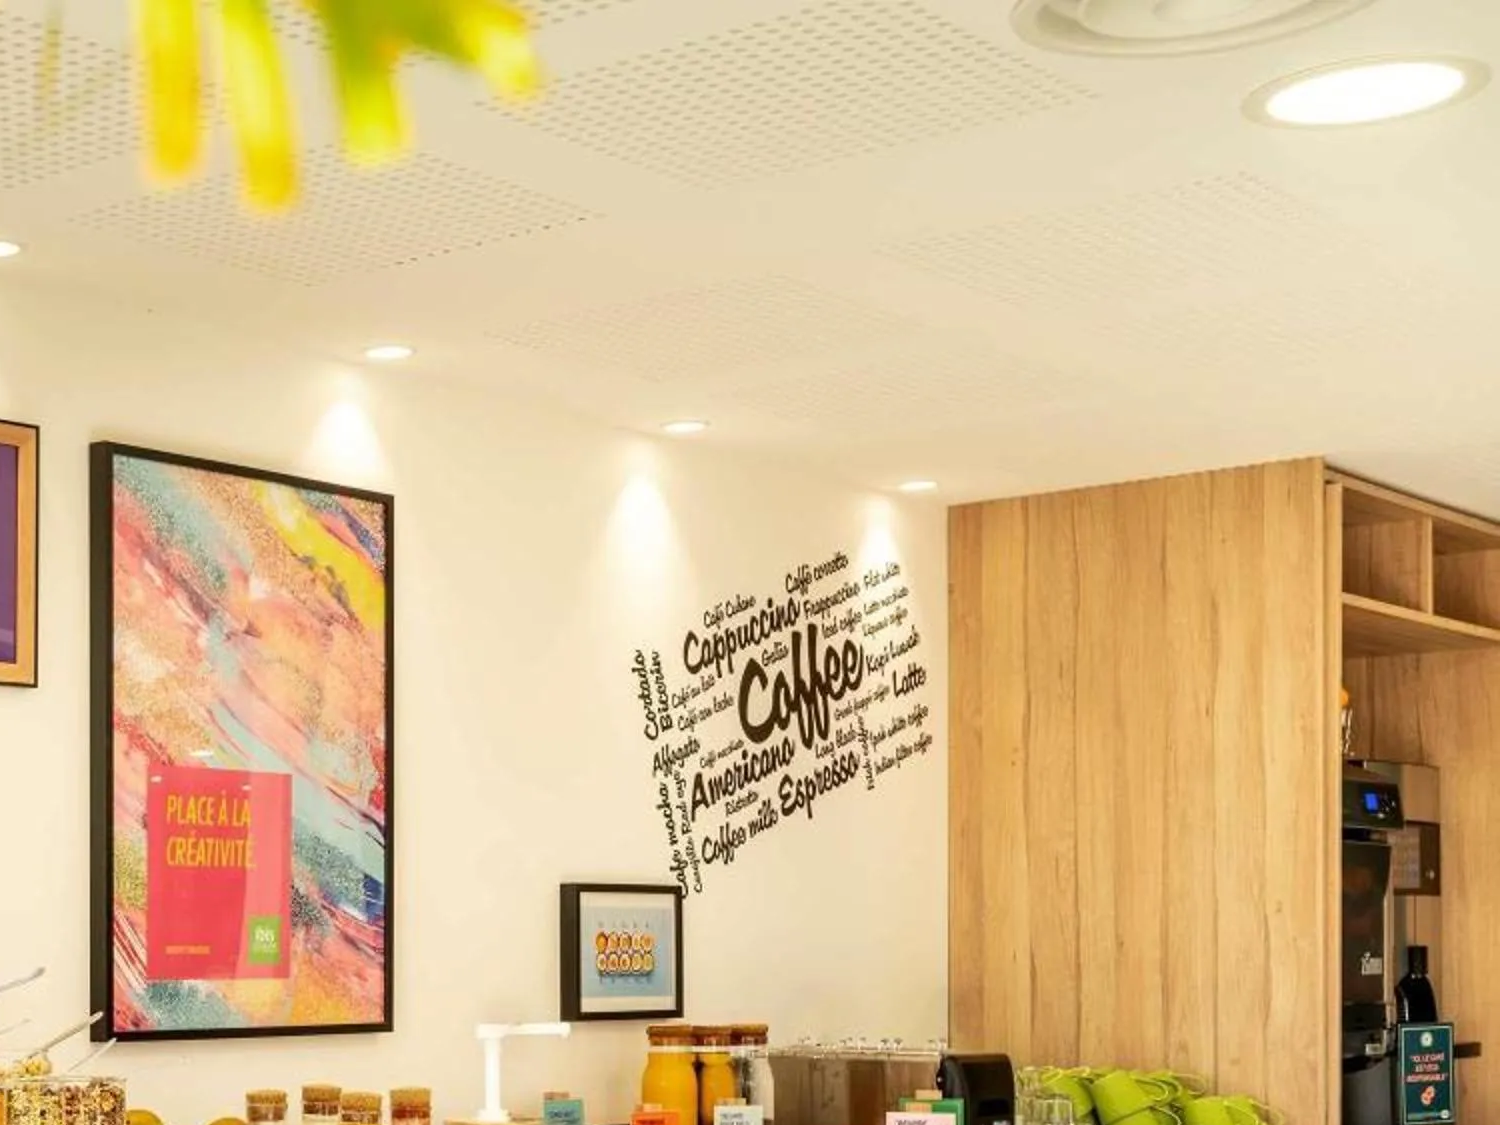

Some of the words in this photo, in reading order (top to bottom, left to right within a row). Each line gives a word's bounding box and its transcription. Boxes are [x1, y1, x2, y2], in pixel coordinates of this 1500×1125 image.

[683, 596, 801, 679] Cappuccino
[865, 645, 890, 676] Kopi
[632, 649, 659, 741] Cortado
[738, 623, 864, 749] Coffee
[892, 661, 927, 699] Latte
[652, 735, 701, 778] Affogato
[690, 736, 796, 823] Americano
[778, 750, 861, 820] Espresso
[165, 793, 215, 826] PLACE
[217, 790, 228, 826] À
[232, 797, 252, 827] LA
[656, 781, 678, 846] mocha
[676, 801, 692, 836] Red
[700, 821, 747, 865] Coffee
[748, 797, 779, 839] milk
